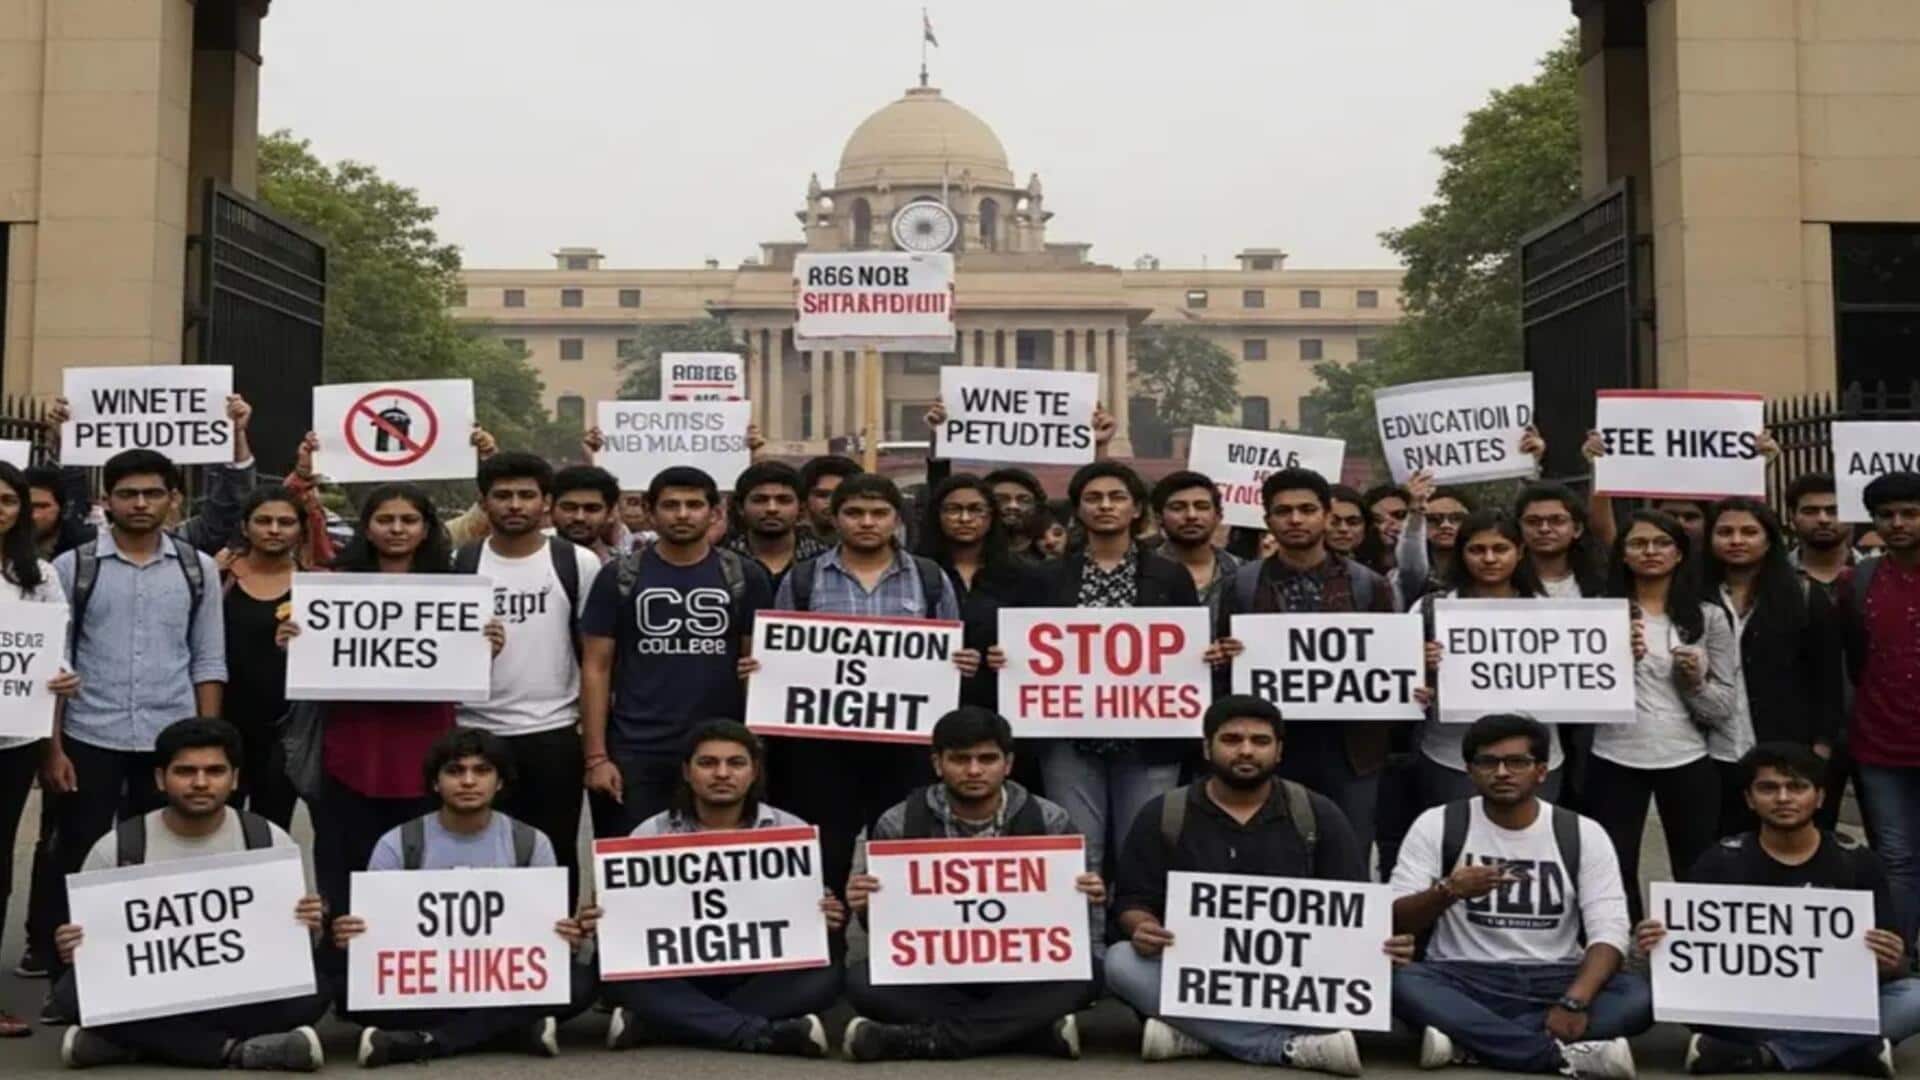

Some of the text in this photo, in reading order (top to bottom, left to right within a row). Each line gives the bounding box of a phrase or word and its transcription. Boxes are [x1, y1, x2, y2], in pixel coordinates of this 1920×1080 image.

[92, 388, 206, 414] WINETE
[962, 388, 1027, 413] WNE
[76, 420, 227, 448] PETUDTES
[947, 420, 1090, 449] PETUDTES
[1667, 429, 1758, 459] HIKES
[308, 600, 402, 630] STOP
[416, 602, 479, 631] FEE
[636, 588, 730, 636] CS
[333, 638, 437, 668] HIKES
[765, 624, 948, 660] EDUCATION
[1029, 623, 1185, 676] STOP
[1290, 628, 1373, 662] NOT
[1449, 628, 1606, 654] EDITOP TO
[836, 660, 866, 686] IS
[1251, 668, 1416, 705] REPACT
[1471, 662, 1616, 689] SGUPTES
[786, 687, 928, 730] RIGHT
[1020, 685, 1201, 718] FEE HIKES
[604, 846, 811, 889] EDUCATION
[910, 858, 1046, 895] LISTEN
[125, 886, 253, 932] GATOP
[418, 891, 504, 937] STOP
[692, 889, 727, 919] IS
[954, 899, 1006, 923] TO
[1191, 882, 1364, 928] REFORM
[1665, 899, 1853, 939] LISTEN TO
[127, 929, 244, 976] HIKES
[647, 920, 789, 966] RIGHT
[892, 927, 1071, 966] STUDETS
[1224, 928, 1310, 967] NOT
[1670, 940, 1822, 979] STUDST
[378, 947, 547, 994] FEE HIKES
[1179, 968, 1371, 1015] RETRATS
